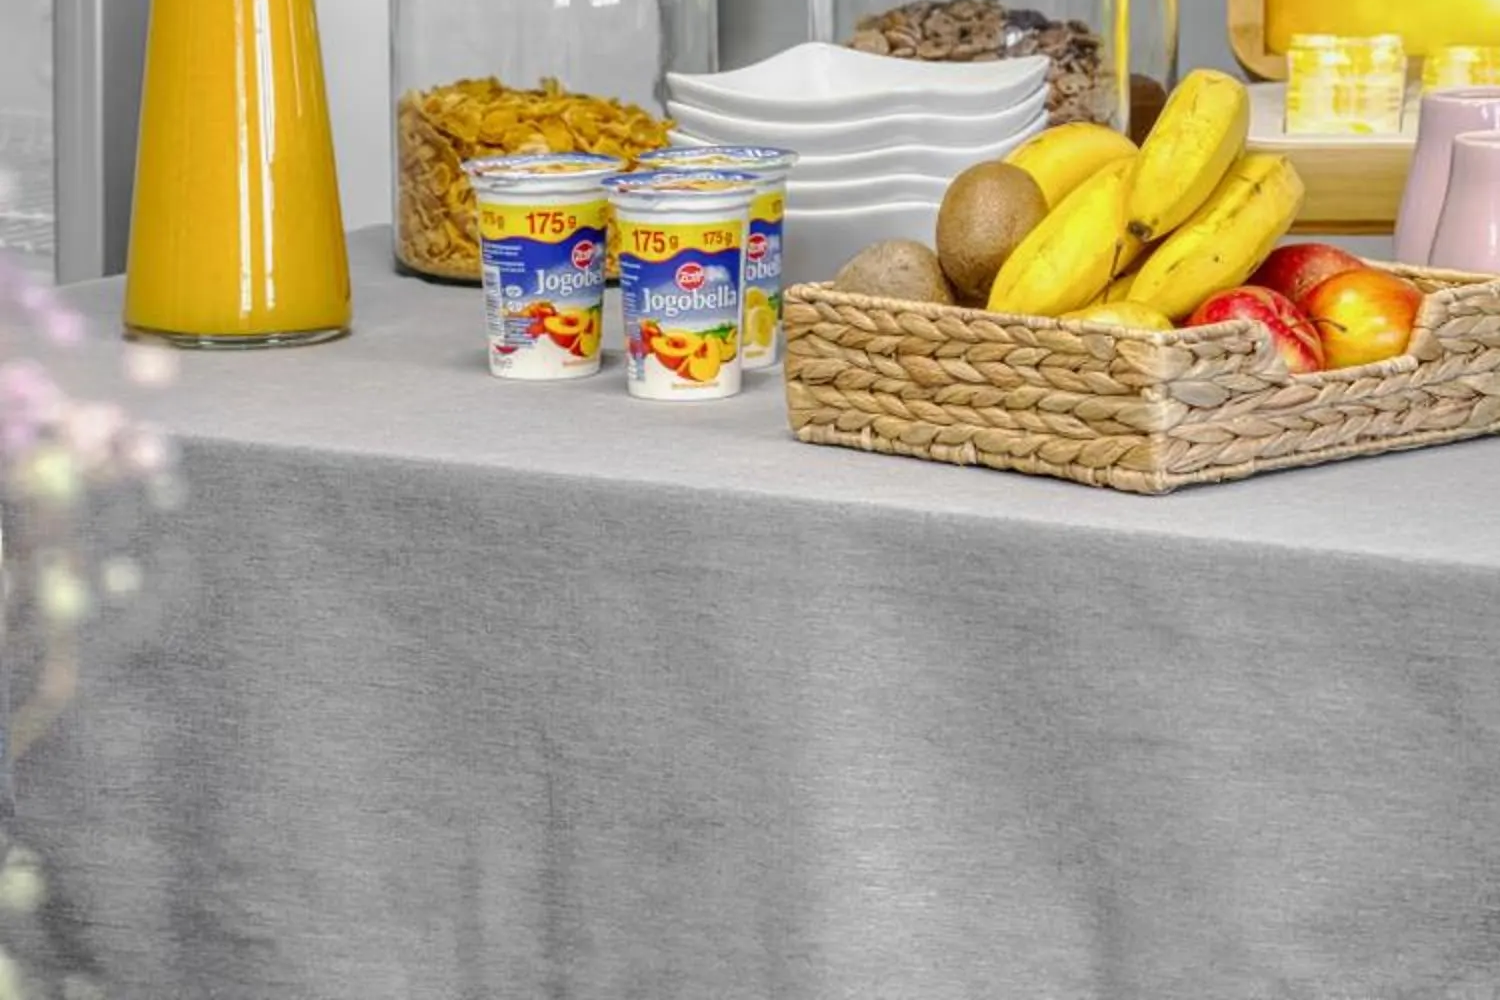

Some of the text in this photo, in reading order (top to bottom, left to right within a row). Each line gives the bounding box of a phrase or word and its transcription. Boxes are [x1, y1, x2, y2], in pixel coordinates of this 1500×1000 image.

[526, 211, 564, 234] 175
[632, 229, 665, 253] 175
[703, 230, 722, 245] 175
[642, 285, 738, 317] Jogobella
